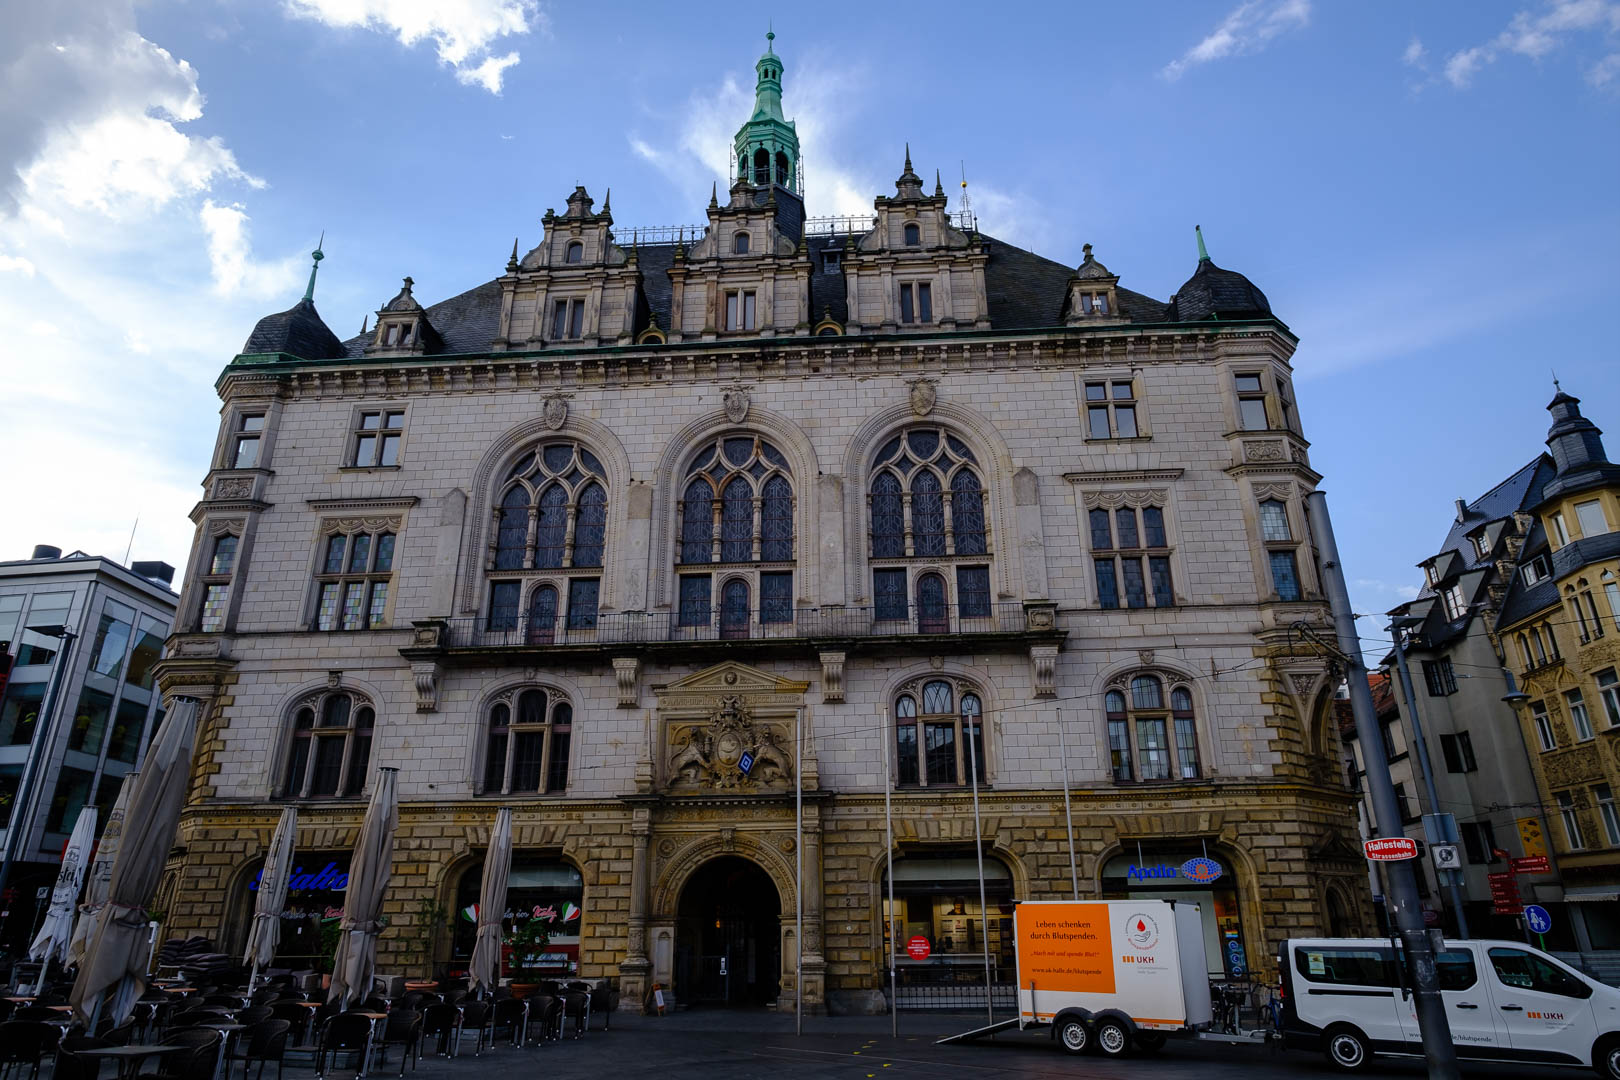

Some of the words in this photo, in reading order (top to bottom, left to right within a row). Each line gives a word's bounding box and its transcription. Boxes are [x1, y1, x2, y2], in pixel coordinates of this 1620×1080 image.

[1368, 840, 1412, 852] Haltestelle
[1128, 864, 1177, 881] Apollo
[532, 904, 558, 924] Italy
[1035, 920, 1057, 928] Leben
[1058, 920, 1091, 928] schenken
[1030, 932, 1051, 940] durch
[1052, 932, 1098, 942] Blutspenden.
[1136, 956, 1155, 964] UKH
